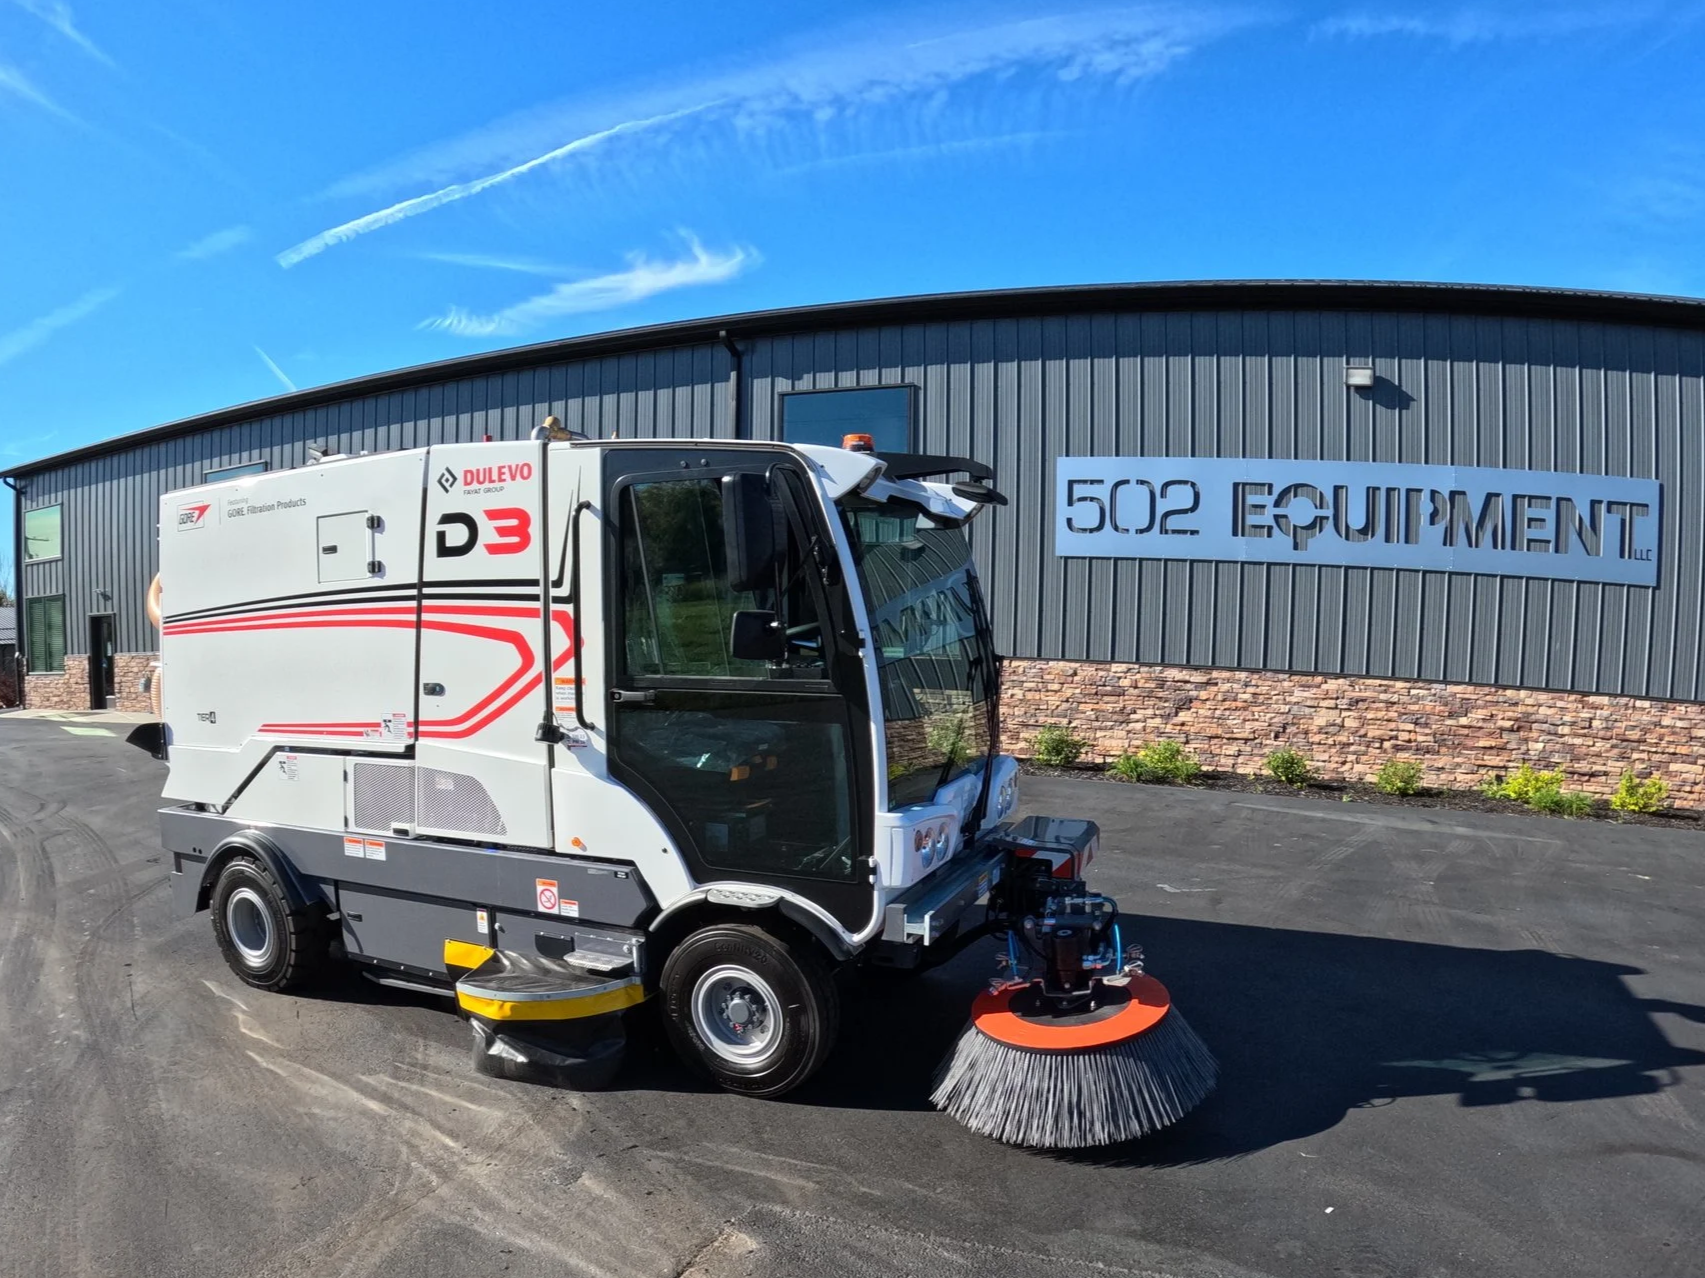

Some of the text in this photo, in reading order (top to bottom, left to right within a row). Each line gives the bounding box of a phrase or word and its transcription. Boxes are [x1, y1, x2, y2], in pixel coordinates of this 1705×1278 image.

[463, 463, 532, 486] DULEVO
[247, 503, 275, 515] Filtration
[277, 498, 306, 509] Products
[179, 512, 196, 525] GORE
[1066, 479, 1650, 560] 502 EQUIPMENT
[436, 507, 531, 558] D3
[1634, 549, 1652, 561] LLC
